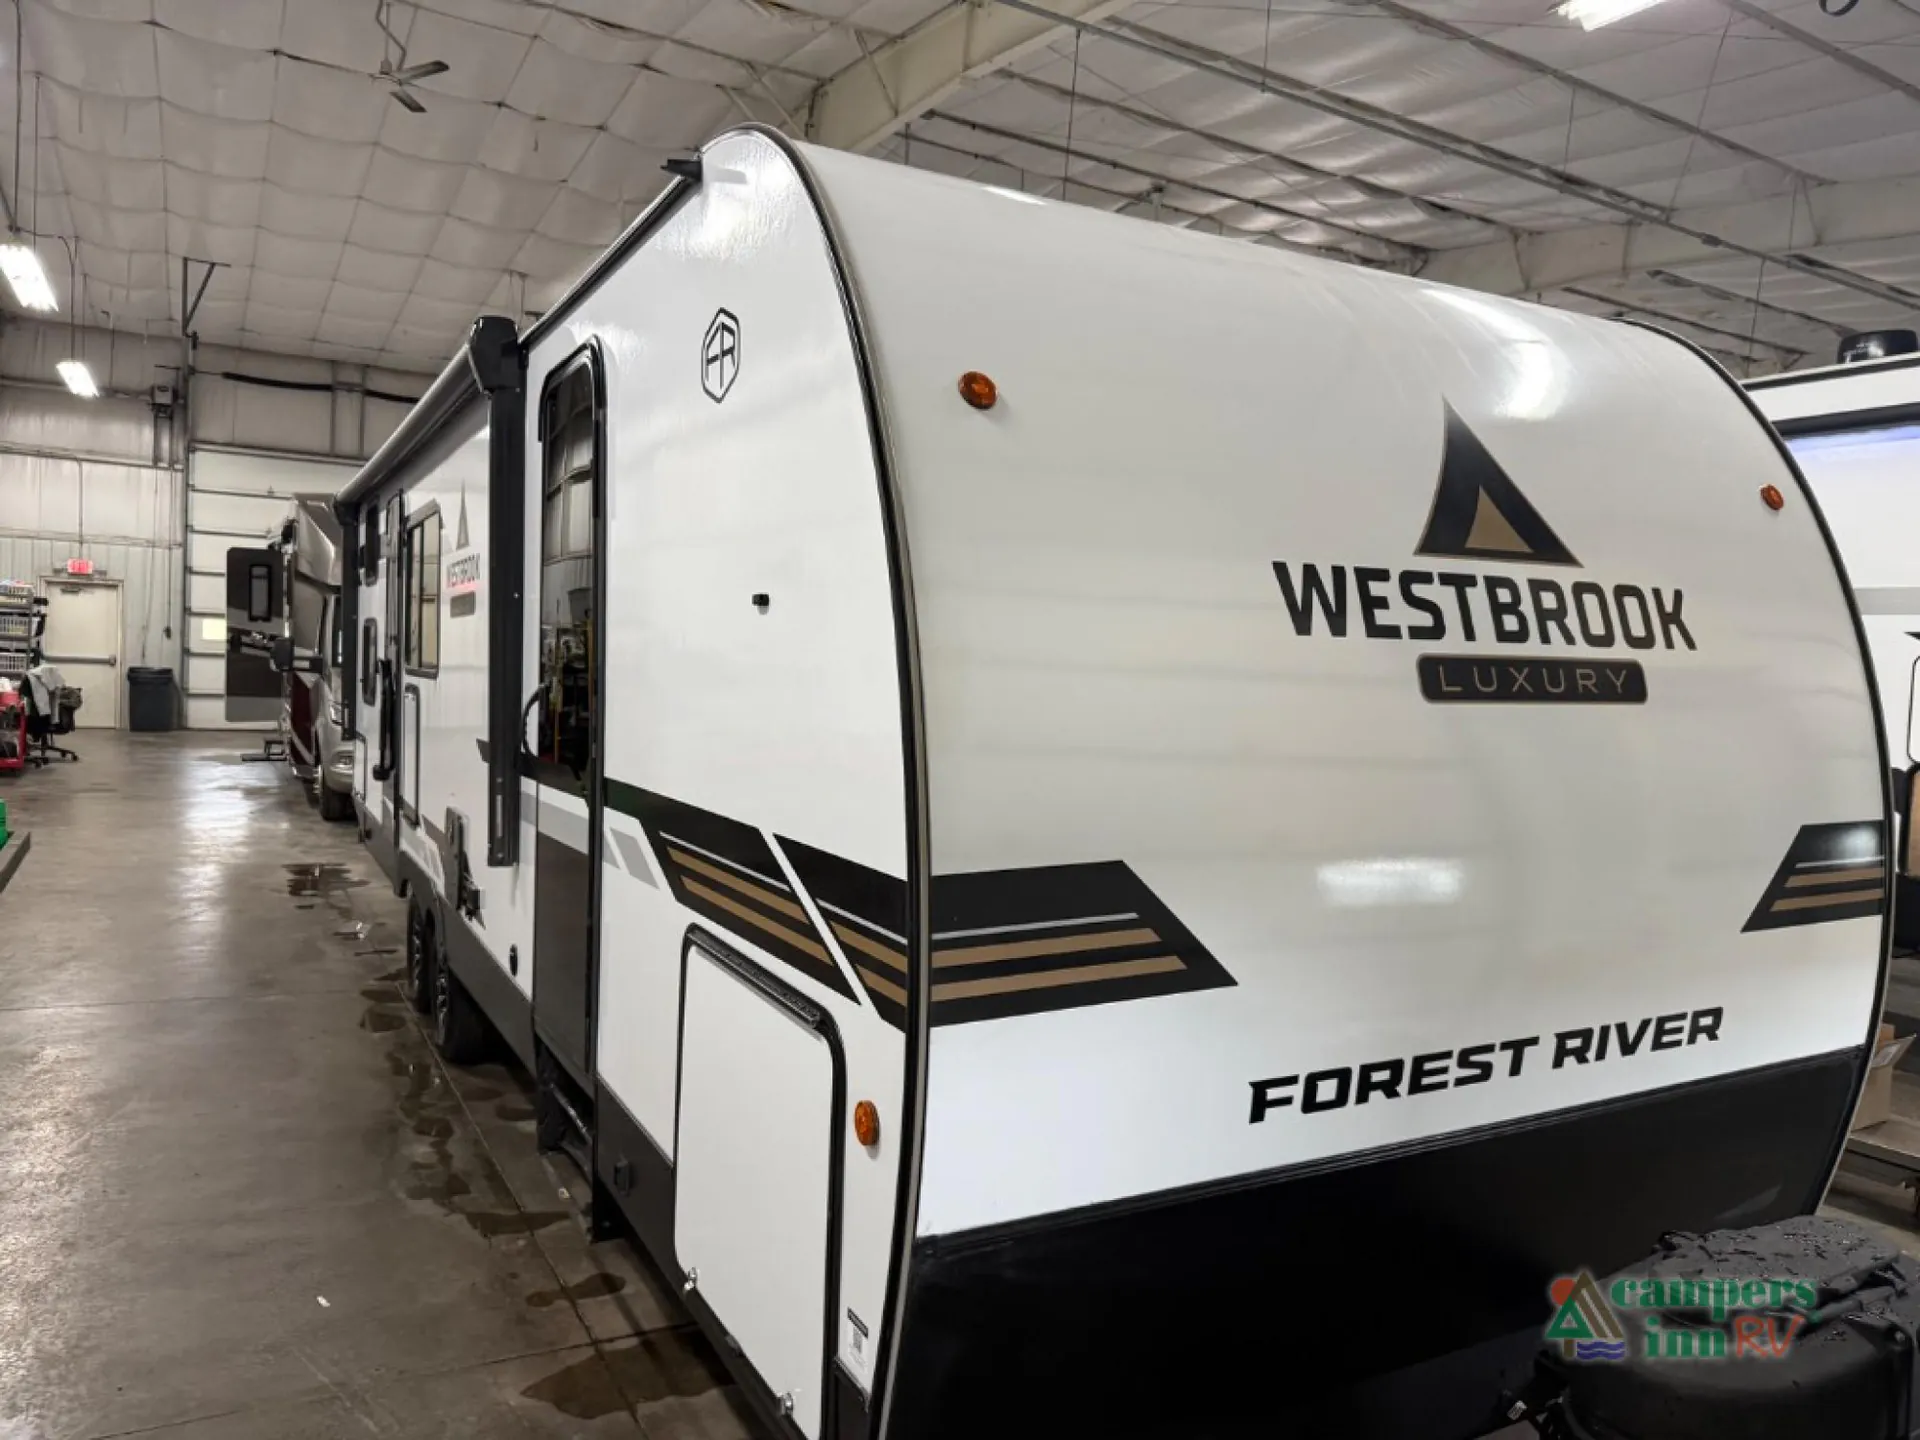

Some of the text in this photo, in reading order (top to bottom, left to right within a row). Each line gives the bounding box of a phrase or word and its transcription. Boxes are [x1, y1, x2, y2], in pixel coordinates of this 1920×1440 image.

[1272, 561, 1696, 651] WESTBROOK
[1441, 666, 1627, 693] LUXURY
[1249, 1006, 1724, 1123] FOREST RIVER
